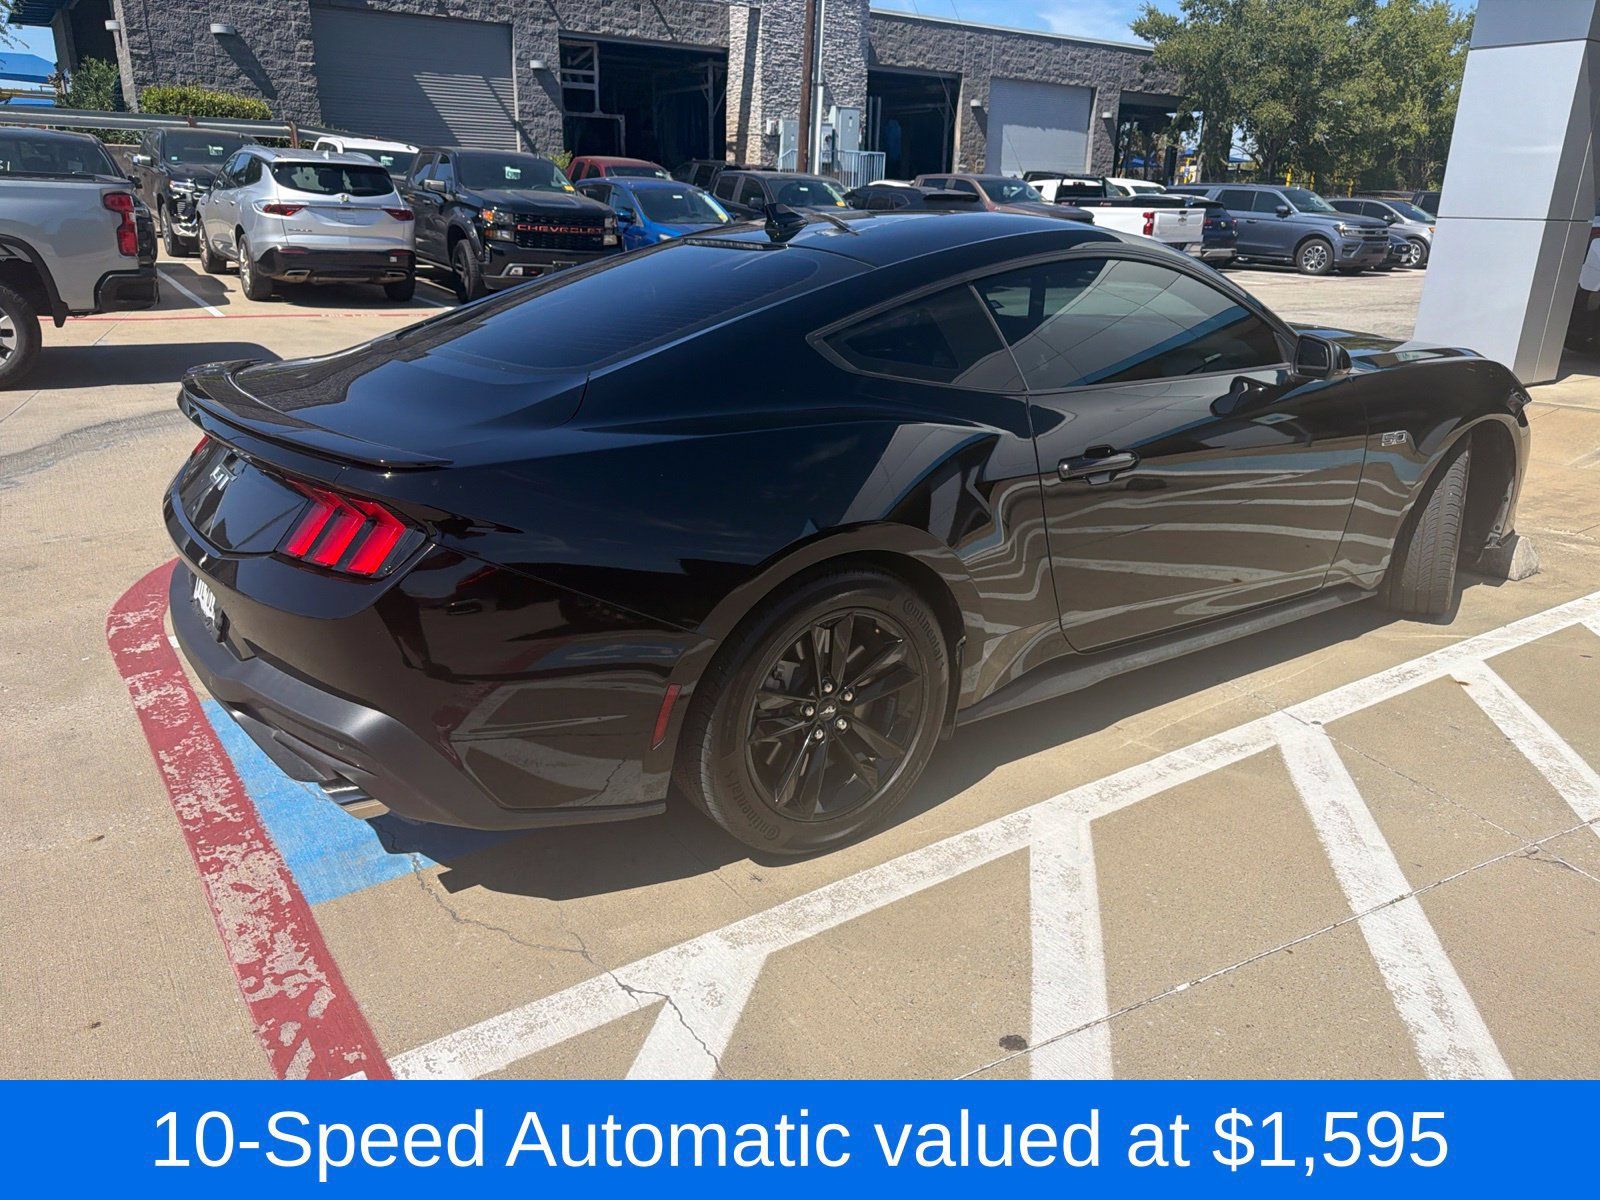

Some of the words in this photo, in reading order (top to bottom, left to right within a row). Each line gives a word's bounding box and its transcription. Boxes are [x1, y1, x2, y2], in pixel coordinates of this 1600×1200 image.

[517, 224, 604, 234] CHEVROLET
[210, 463, 238, 491] GT
[903, 599, 944, 660] Continental
[731, 782, 781, 841] Continental
